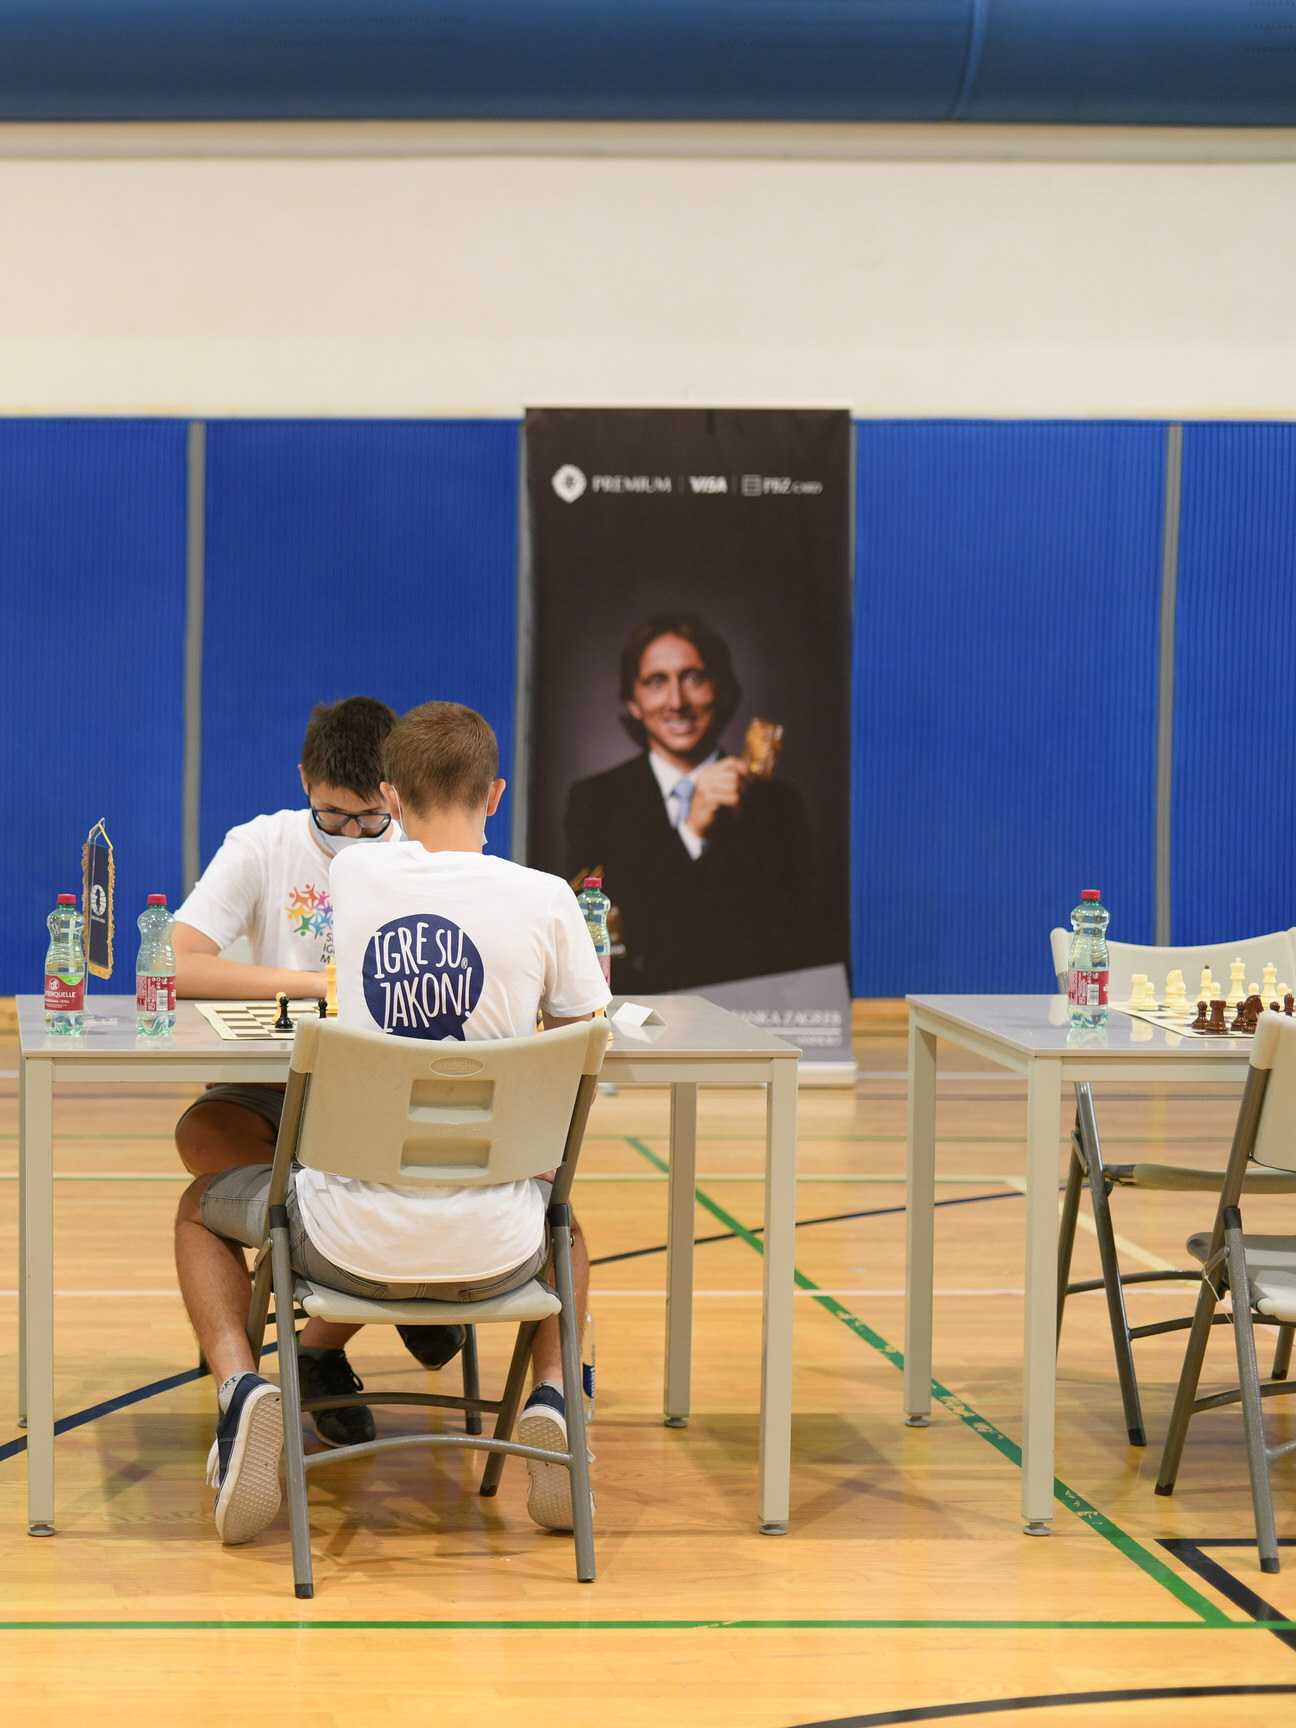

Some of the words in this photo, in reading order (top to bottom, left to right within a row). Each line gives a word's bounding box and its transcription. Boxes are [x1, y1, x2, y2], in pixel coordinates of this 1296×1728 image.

[592, 475, 672, 494] PREMIUM
[689, 475, 728, 494] VISA
[374, 922, 429, 979] IGRE
[436, 928, 464, 968] SU
[380, 967, 473, 1033] ZAKON!
